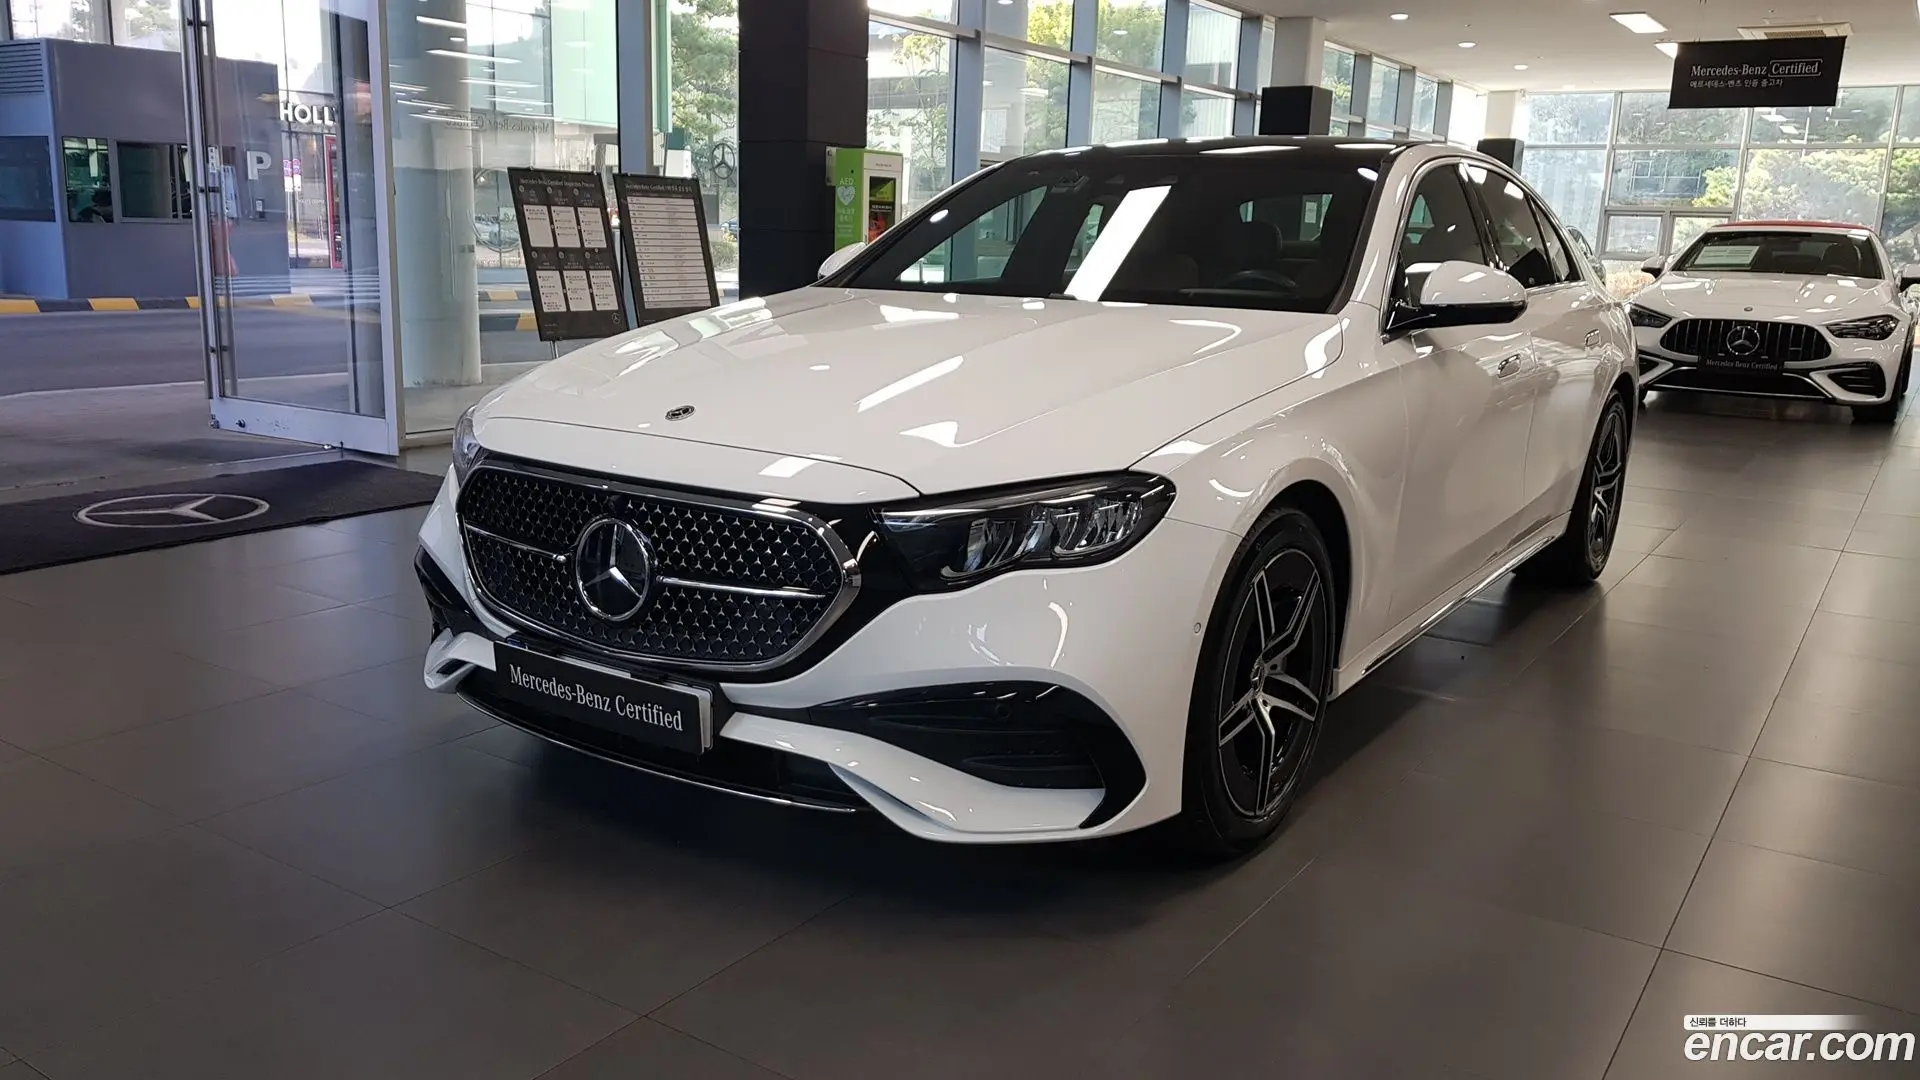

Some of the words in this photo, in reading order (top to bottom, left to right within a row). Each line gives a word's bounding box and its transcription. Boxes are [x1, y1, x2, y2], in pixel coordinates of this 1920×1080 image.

[1691, 64, 1767, 76] Mercedes-Benz
[1772, 62, 1819, 74] Certified
[280, 103, 336, 126] HOLL
[247, 151, 271, 180] P
[510, 664, 611, 712] Mercedes-Benz
[615, 695, 684, 731] Certified
